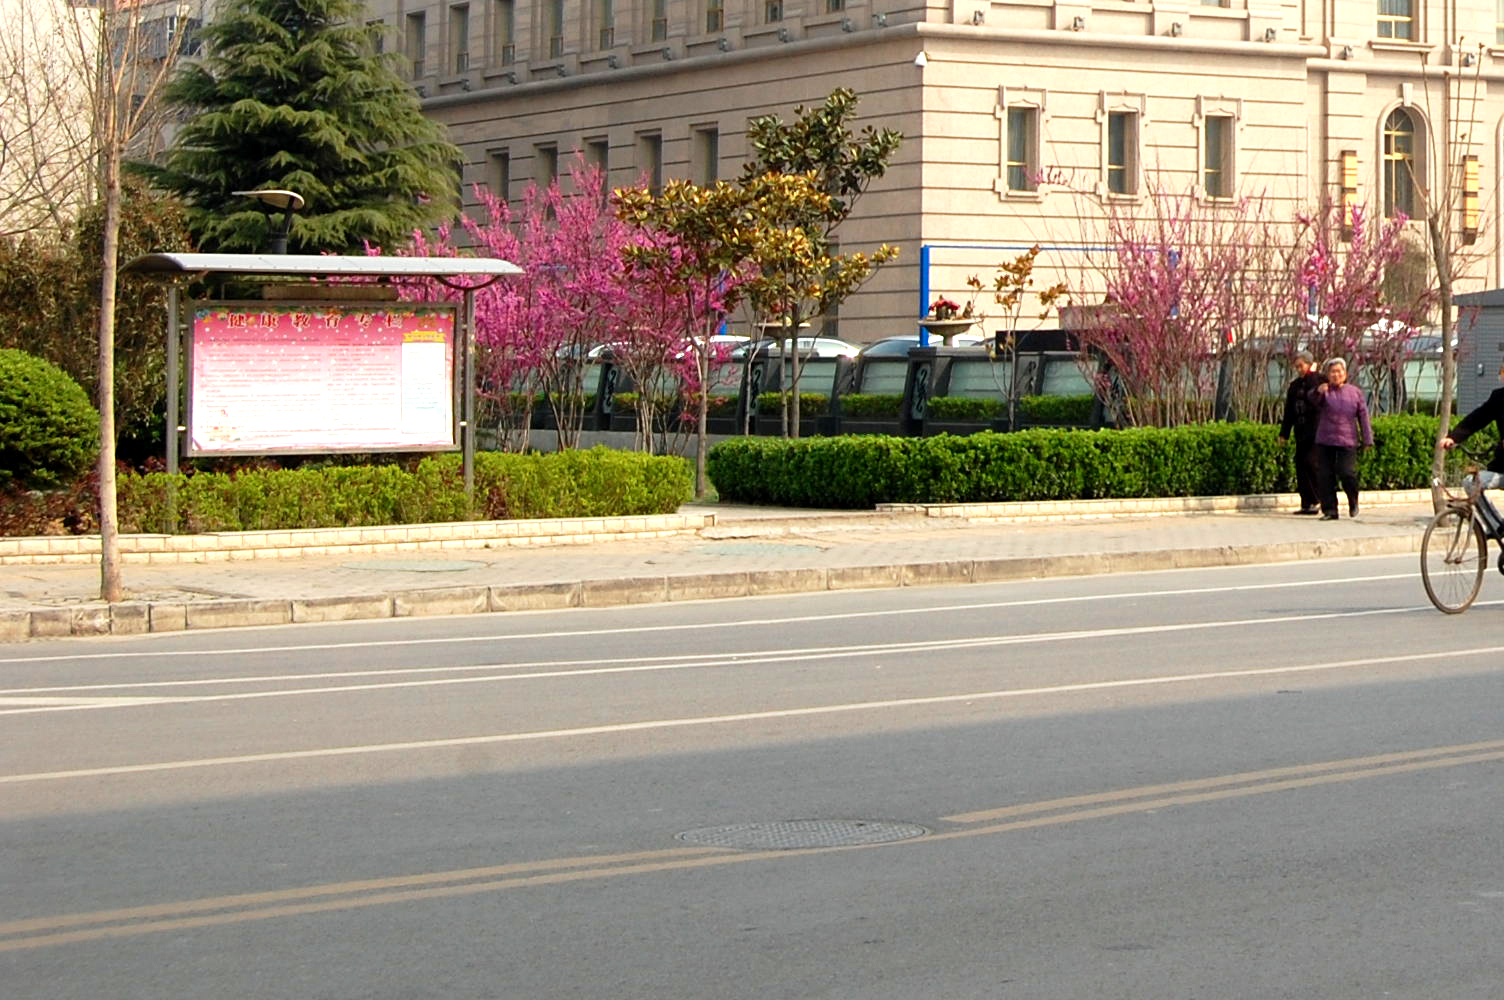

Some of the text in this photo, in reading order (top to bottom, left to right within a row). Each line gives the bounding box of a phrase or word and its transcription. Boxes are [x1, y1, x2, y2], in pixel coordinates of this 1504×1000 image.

[227, 312, 403, 329] 健康教育专栏
